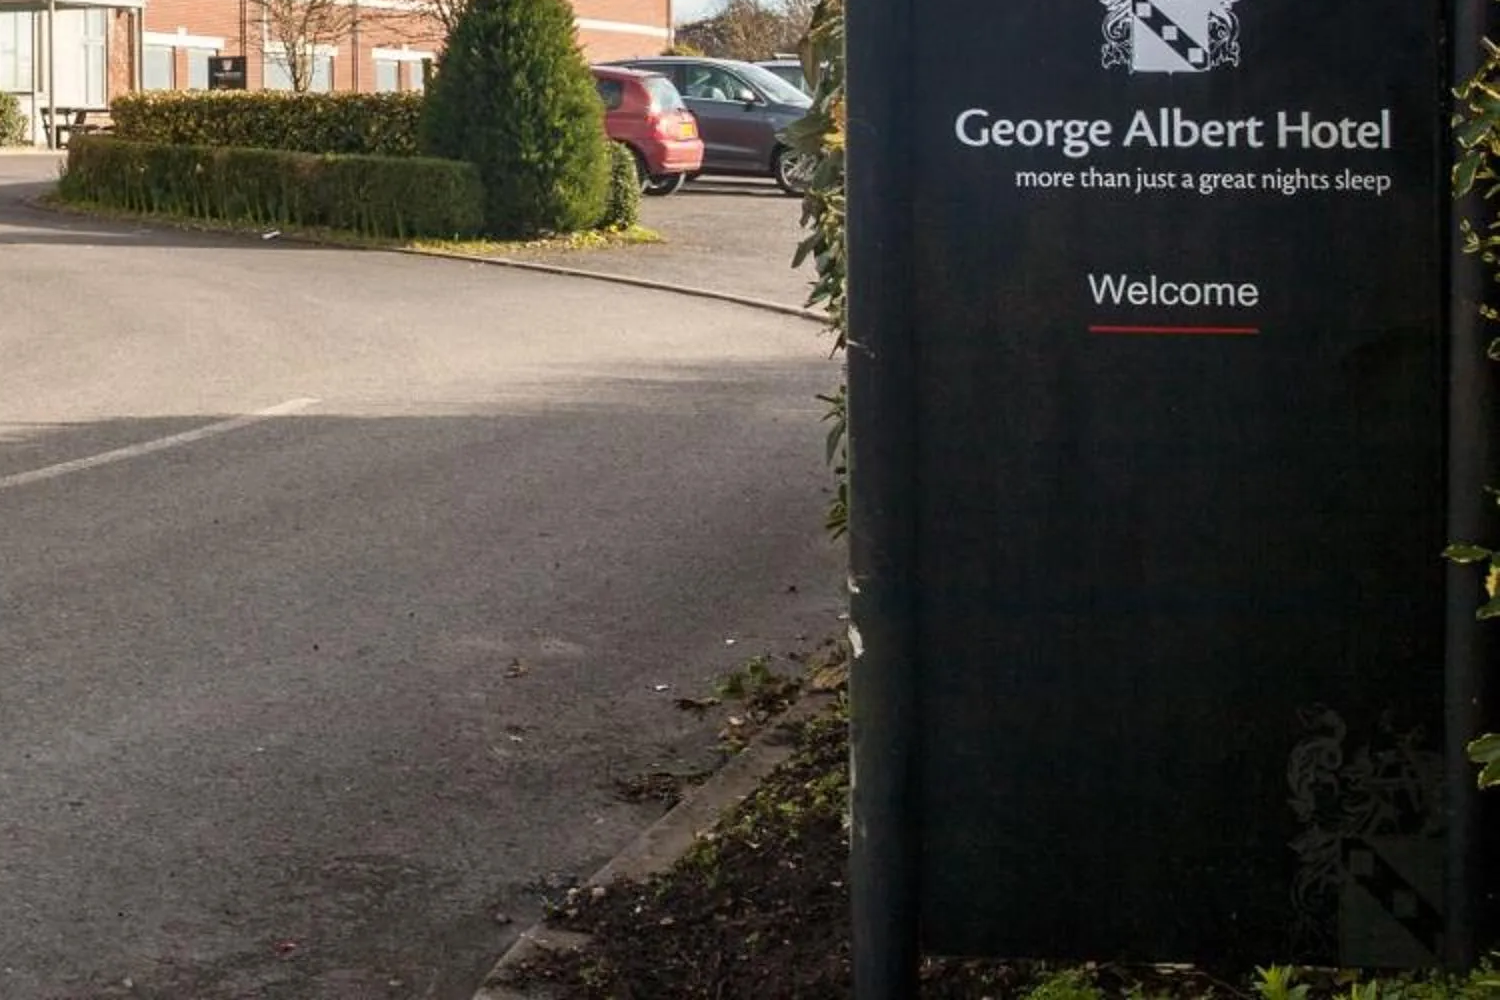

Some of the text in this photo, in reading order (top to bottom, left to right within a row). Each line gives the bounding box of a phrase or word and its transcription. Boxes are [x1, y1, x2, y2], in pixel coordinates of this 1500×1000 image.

[955, 108, 1391, 158] George Albert Hotel
[1015, 166, 1392, 196] more than just a great nights sleep
[1087, 273, 1260, 307] Welcome
